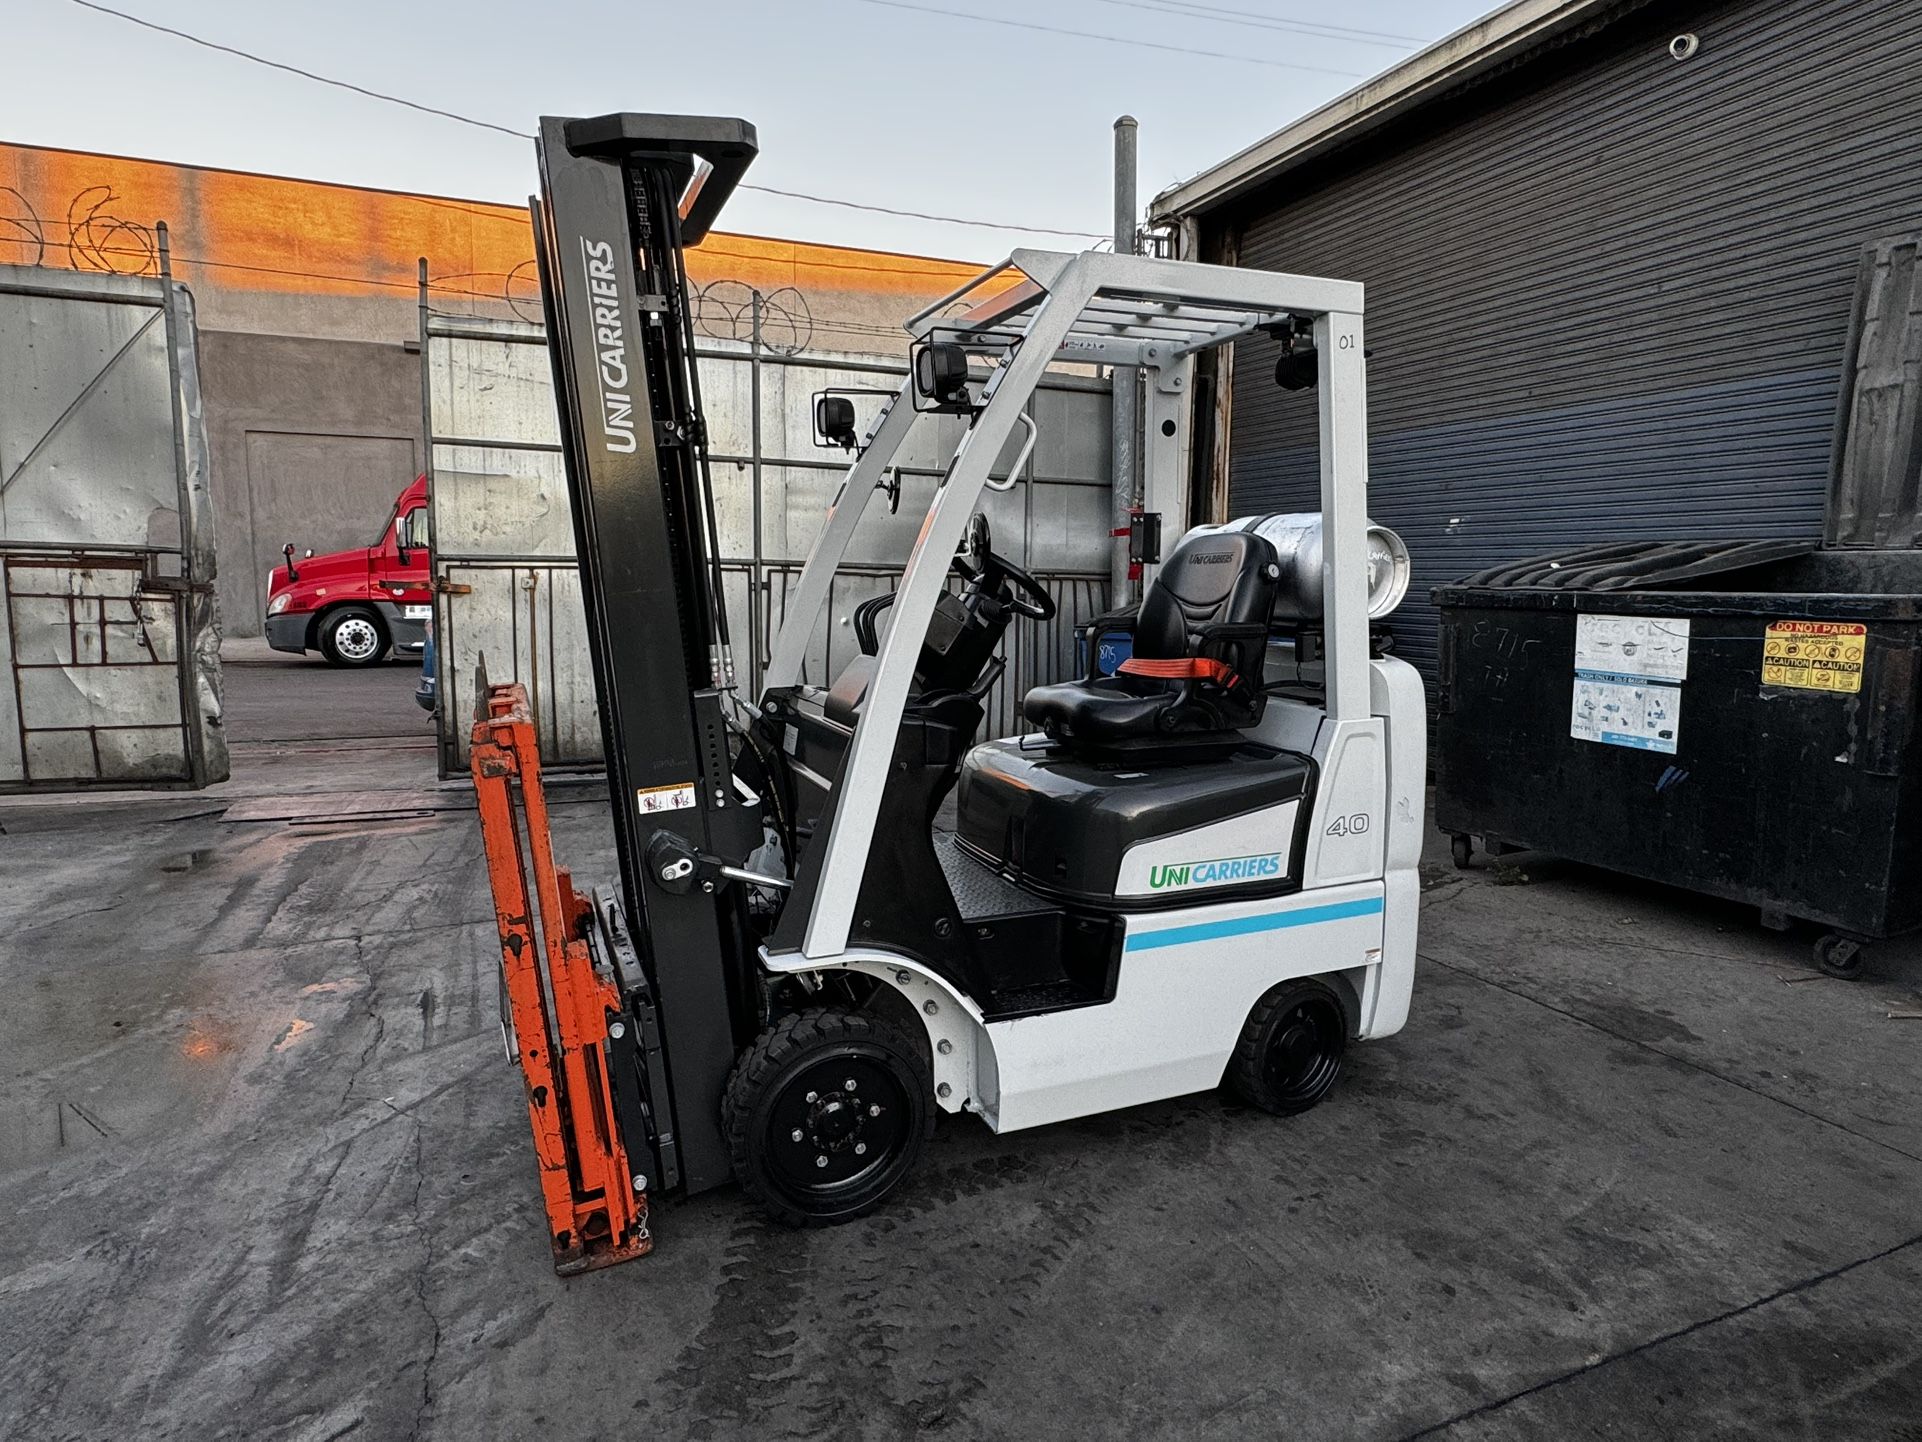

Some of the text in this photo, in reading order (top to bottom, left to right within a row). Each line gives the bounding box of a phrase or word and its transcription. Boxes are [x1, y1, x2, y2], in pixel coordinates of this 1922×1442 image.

[1339, 335, 1355, 350] 01
[1776, 622, 1856, 634] DO NOT PARK
[1772, 657, 1809, 667] CAUTION
[1821, 662, 1860, 671] CAUTION
[1326, 813, 1370, 837] 40
